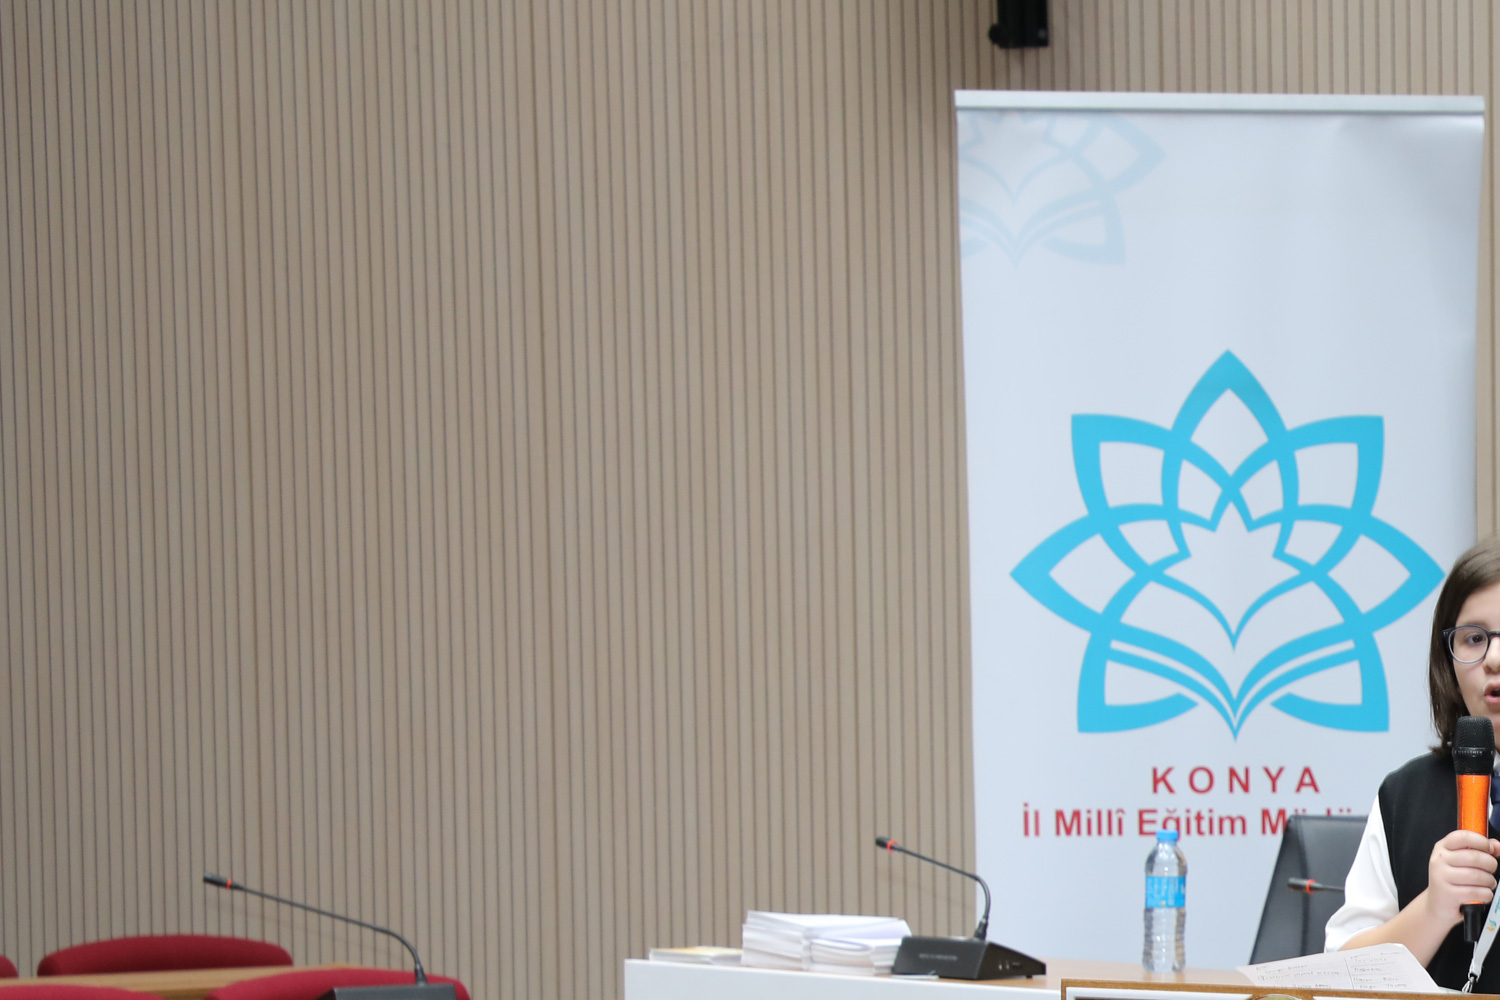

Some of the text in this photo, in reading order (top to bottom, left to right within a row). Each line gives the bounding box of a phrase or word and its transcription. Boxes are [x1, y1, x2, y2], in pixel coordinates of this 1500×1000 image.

[1151, 766, 1320, 794] KONYA
[1023, 802, 1041, 837] İl
[1055, 808, 1126, 837] Millî
[1138, 807, 1247, 842] Eğitim
